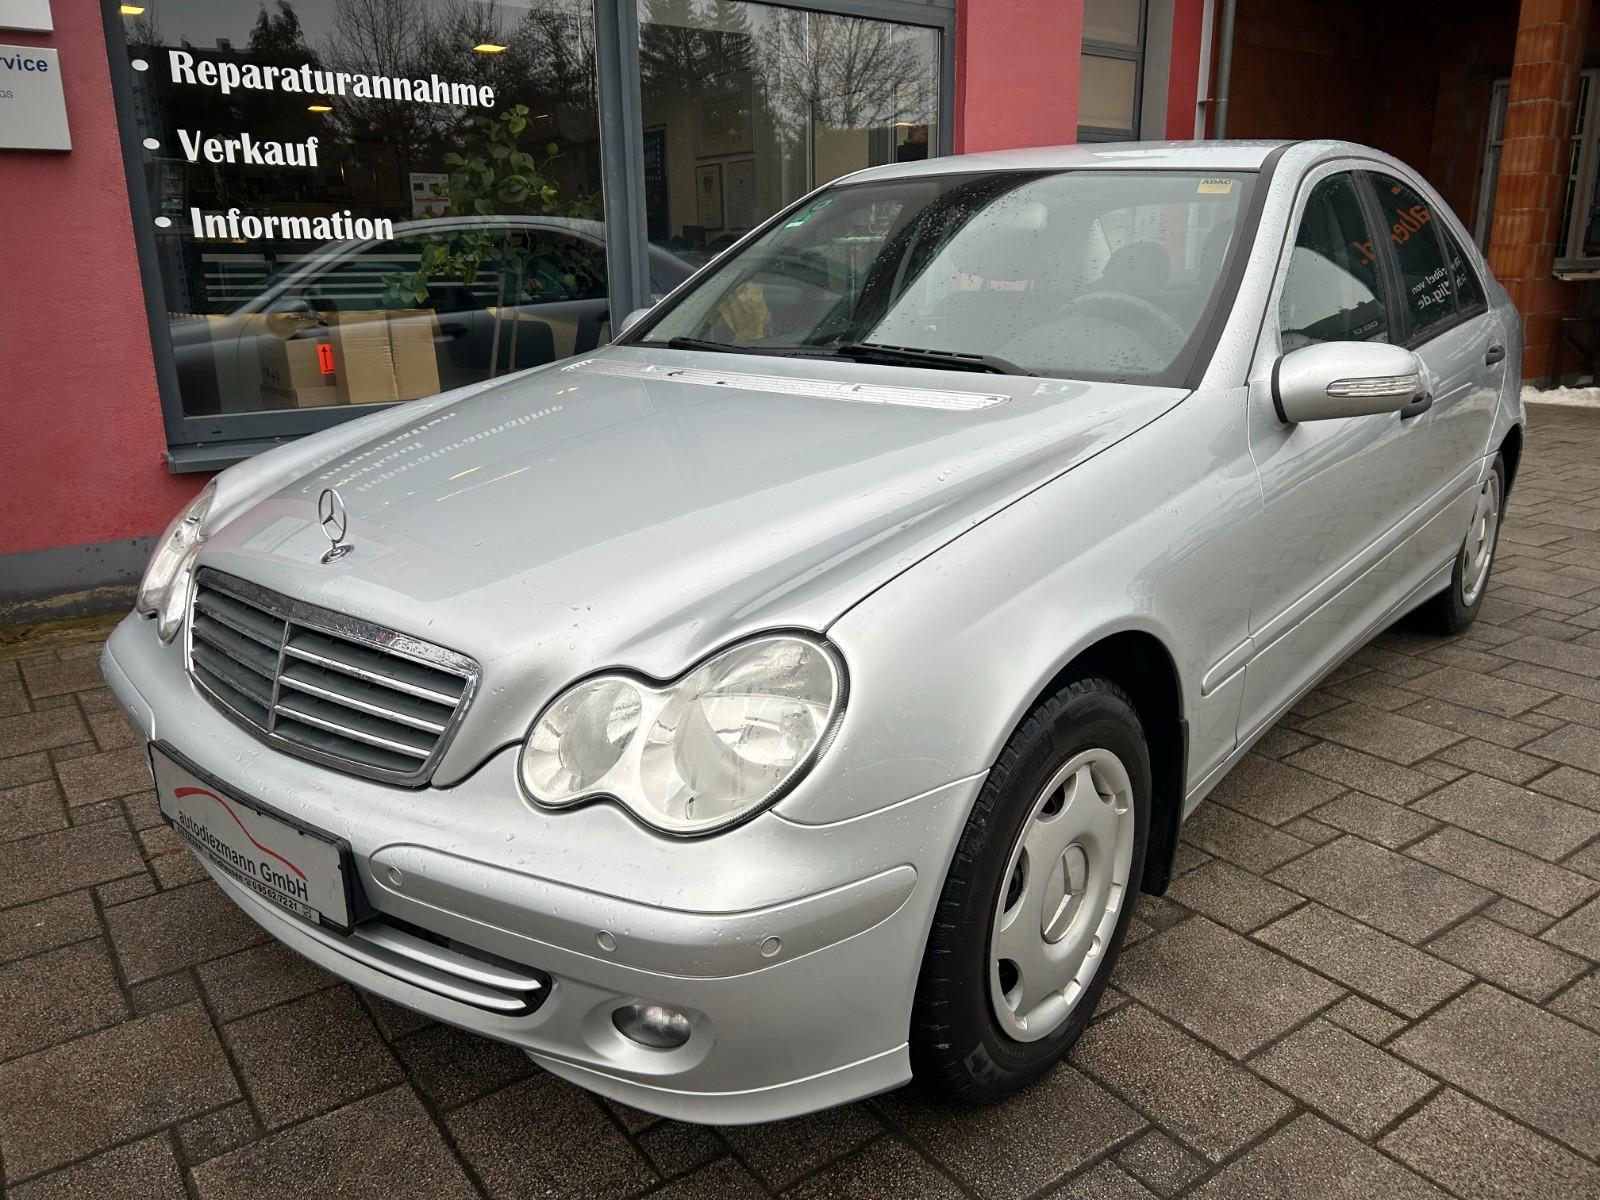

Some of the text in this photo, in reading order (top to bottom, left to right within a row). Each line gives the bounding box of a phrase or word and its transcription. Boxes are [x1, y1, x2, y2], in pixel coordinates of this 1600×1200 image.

[168, 50, 495, 107] Reparaturannahme
[177, 129, 319, 167] Verkauf
[190, 207, 394, 240] Information
[178, 811, 309, 901] autodiezmann GmbH
